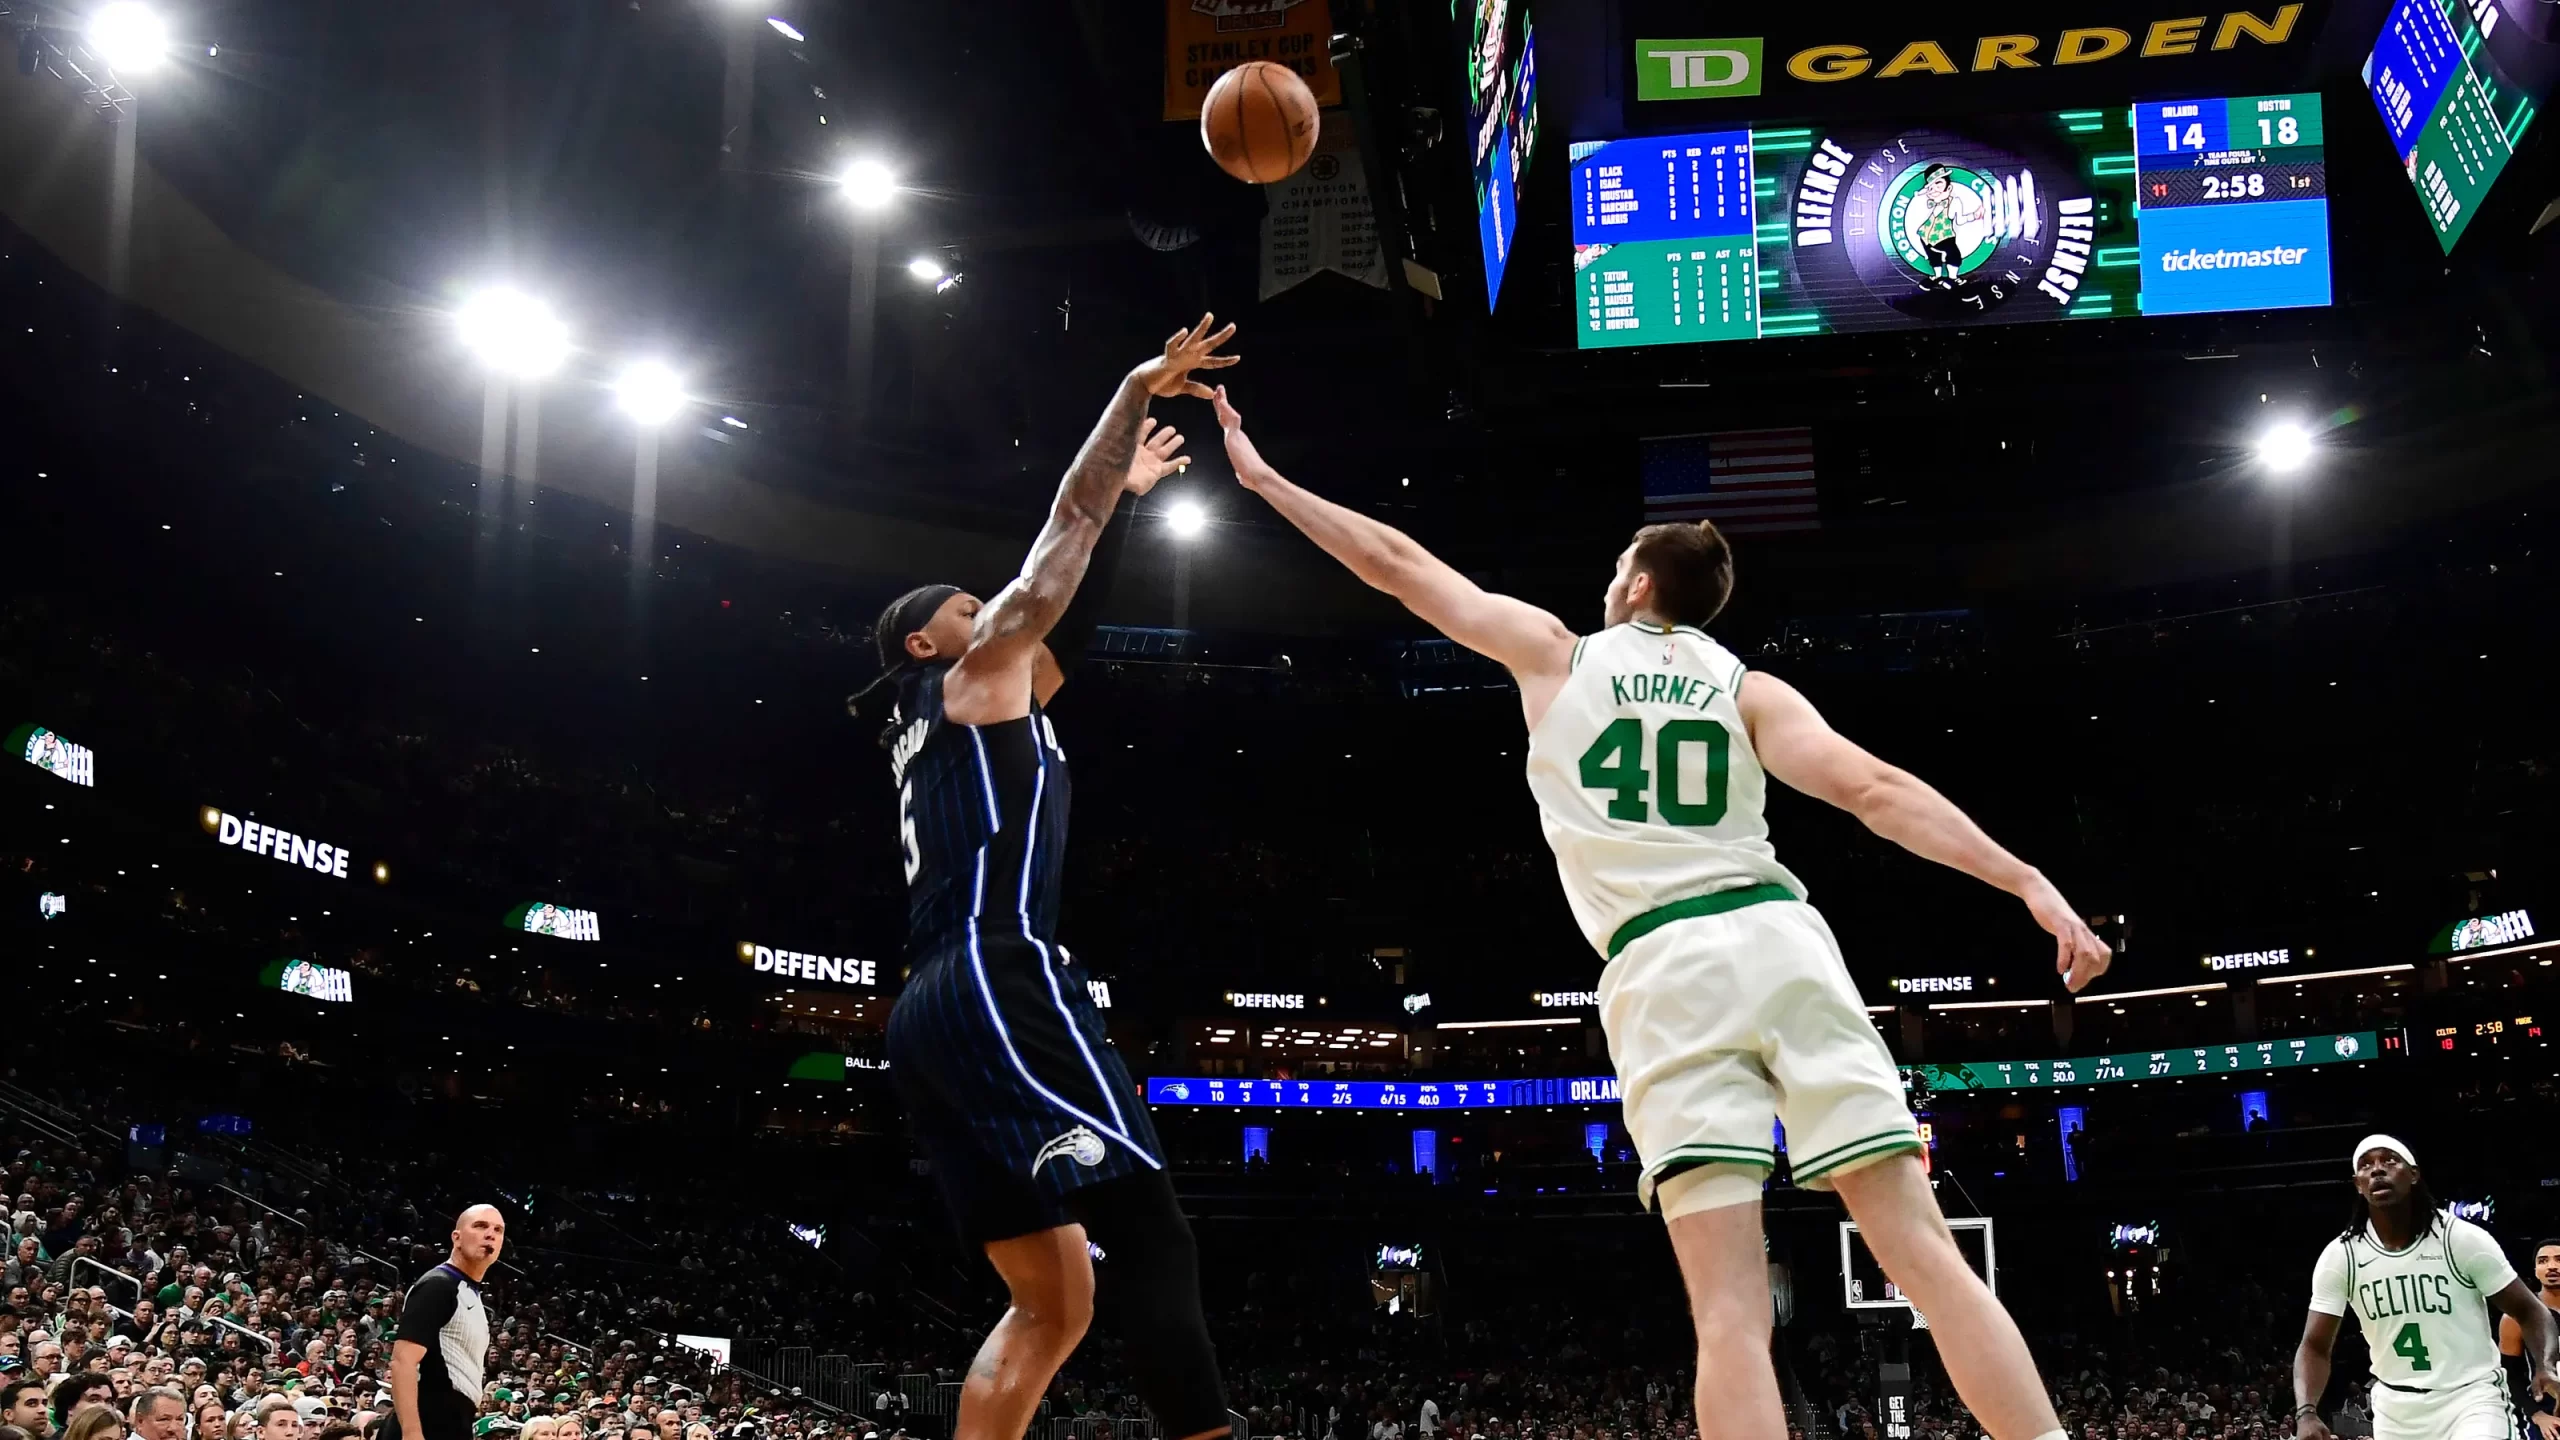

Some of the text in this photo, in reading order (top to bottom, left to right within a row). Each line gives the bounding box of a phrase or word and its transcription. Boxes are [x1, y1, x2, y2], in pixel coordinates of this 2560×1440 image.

[1187, 35, 1314, 63] STANLEY CUP
[1648, 50, 1749, 88] TD
[1787, 3, 2303, 82] GARDEN
[2162, 104, 2199, 118] ORLANDO
[2257, 99, 2291, 113] BOSTON
[2164, 123, 2205, 150] 14
[2258, 117, 2298, 145] 18
[1662, 144, 1749, 159] PTS REB AST FLS
[1599, 165, 1623, 178] BLACK
[1691, 160, 1699, 171] 2
[1291, 184, 1357, 196] DIVISION
[1599, 177, 1622, 190] ISAAC
[1668, 173, 1675, 185] 2
[1848, 138, 1909, 236] DEFENSE
[2151, 174, 2311, 198] 11 2:58 1st
[1586, 191, 1593, 203] 2
[1797, 138, 1854, 247] DEFENSE
[1587, 203, 1594, 215] 5
[1669, 197, 1676, 209] 5
[1892, 195, 1920, 262] BOSTON
[1666, 252, 1682, 262] PTS
[1715, 249, 1731, 259] AST
[1739, 248, 1753, 257] FLS
[2037, 197, 2094, 305] DEFENSE
[2162, 246, 2308, 271] ticketmaster
[1602, 270, 1628, 283] TATUM
[1672, 266, 1679, 278] 2
[1611, 674, 1723, 711] KORNET
[1578, 718, 1730, 826] 40
[219, 812, 349, 878] DEFENSE
[754, 945, 876, 985] DEFENSE
[2212, 949, 2290, 970] DEFENSE
[1899, 977, 1972, 993] DEFENSE
[1233, 993, 1304, 1009] DEFENSE
[1541, 991, 1600, 1007] DEFENS
[2475, 1020, 2504, 1036] 2:58
[2528, 1027, 2542, 1038] 14
[2384, 1036, 2400, 1050] 11
[2441, 1038, 2454, 1050] 18
[845, 1057, 876, 1069] BALL.
[1998, 1063, 2012, 1071] FLS
[2024, 1062, 2040, 1070] TOL
[2053, 1061, 2072, 1069] FG%
[2099, 1057, 2111, 1066] FG
[2150, 1052, 2166, 1061] 3PT
[2193, 1049, 2206, 1057] TO
[2257, 1042, 2273, 1052] AST
[2289, 1040, 2306, 1048] REB
[2004, 1050, 2304, 1085] 1 6 50.0 7/14 2/7 2 3 2 7
[1209, 1080, 1224, 1089] REB
[1238, 1081, 1254, 1089] AST
[1298, 1082, 1310, 1090] TO
[1384, 1084, 1396, 1092] FG
[1454, 1084, 1469, 1092] TOL
[1483, 1082, 1497, 1090] FLS
[1571, 1080, 1621, 1101] ORLAN
[1211, 1090, 1495, 1106] 10 3 1 4 2/5 6/15 40.0 7 3
[2359, 1274, 2452, 1321] CELTICS
[2392, 1323, 2431, 1371] 4
[1889, 1396, 1904, 1409] GET
[1890, 1410, 1906, 1422] THE
[1895, 1424, 1910, 1439] App
